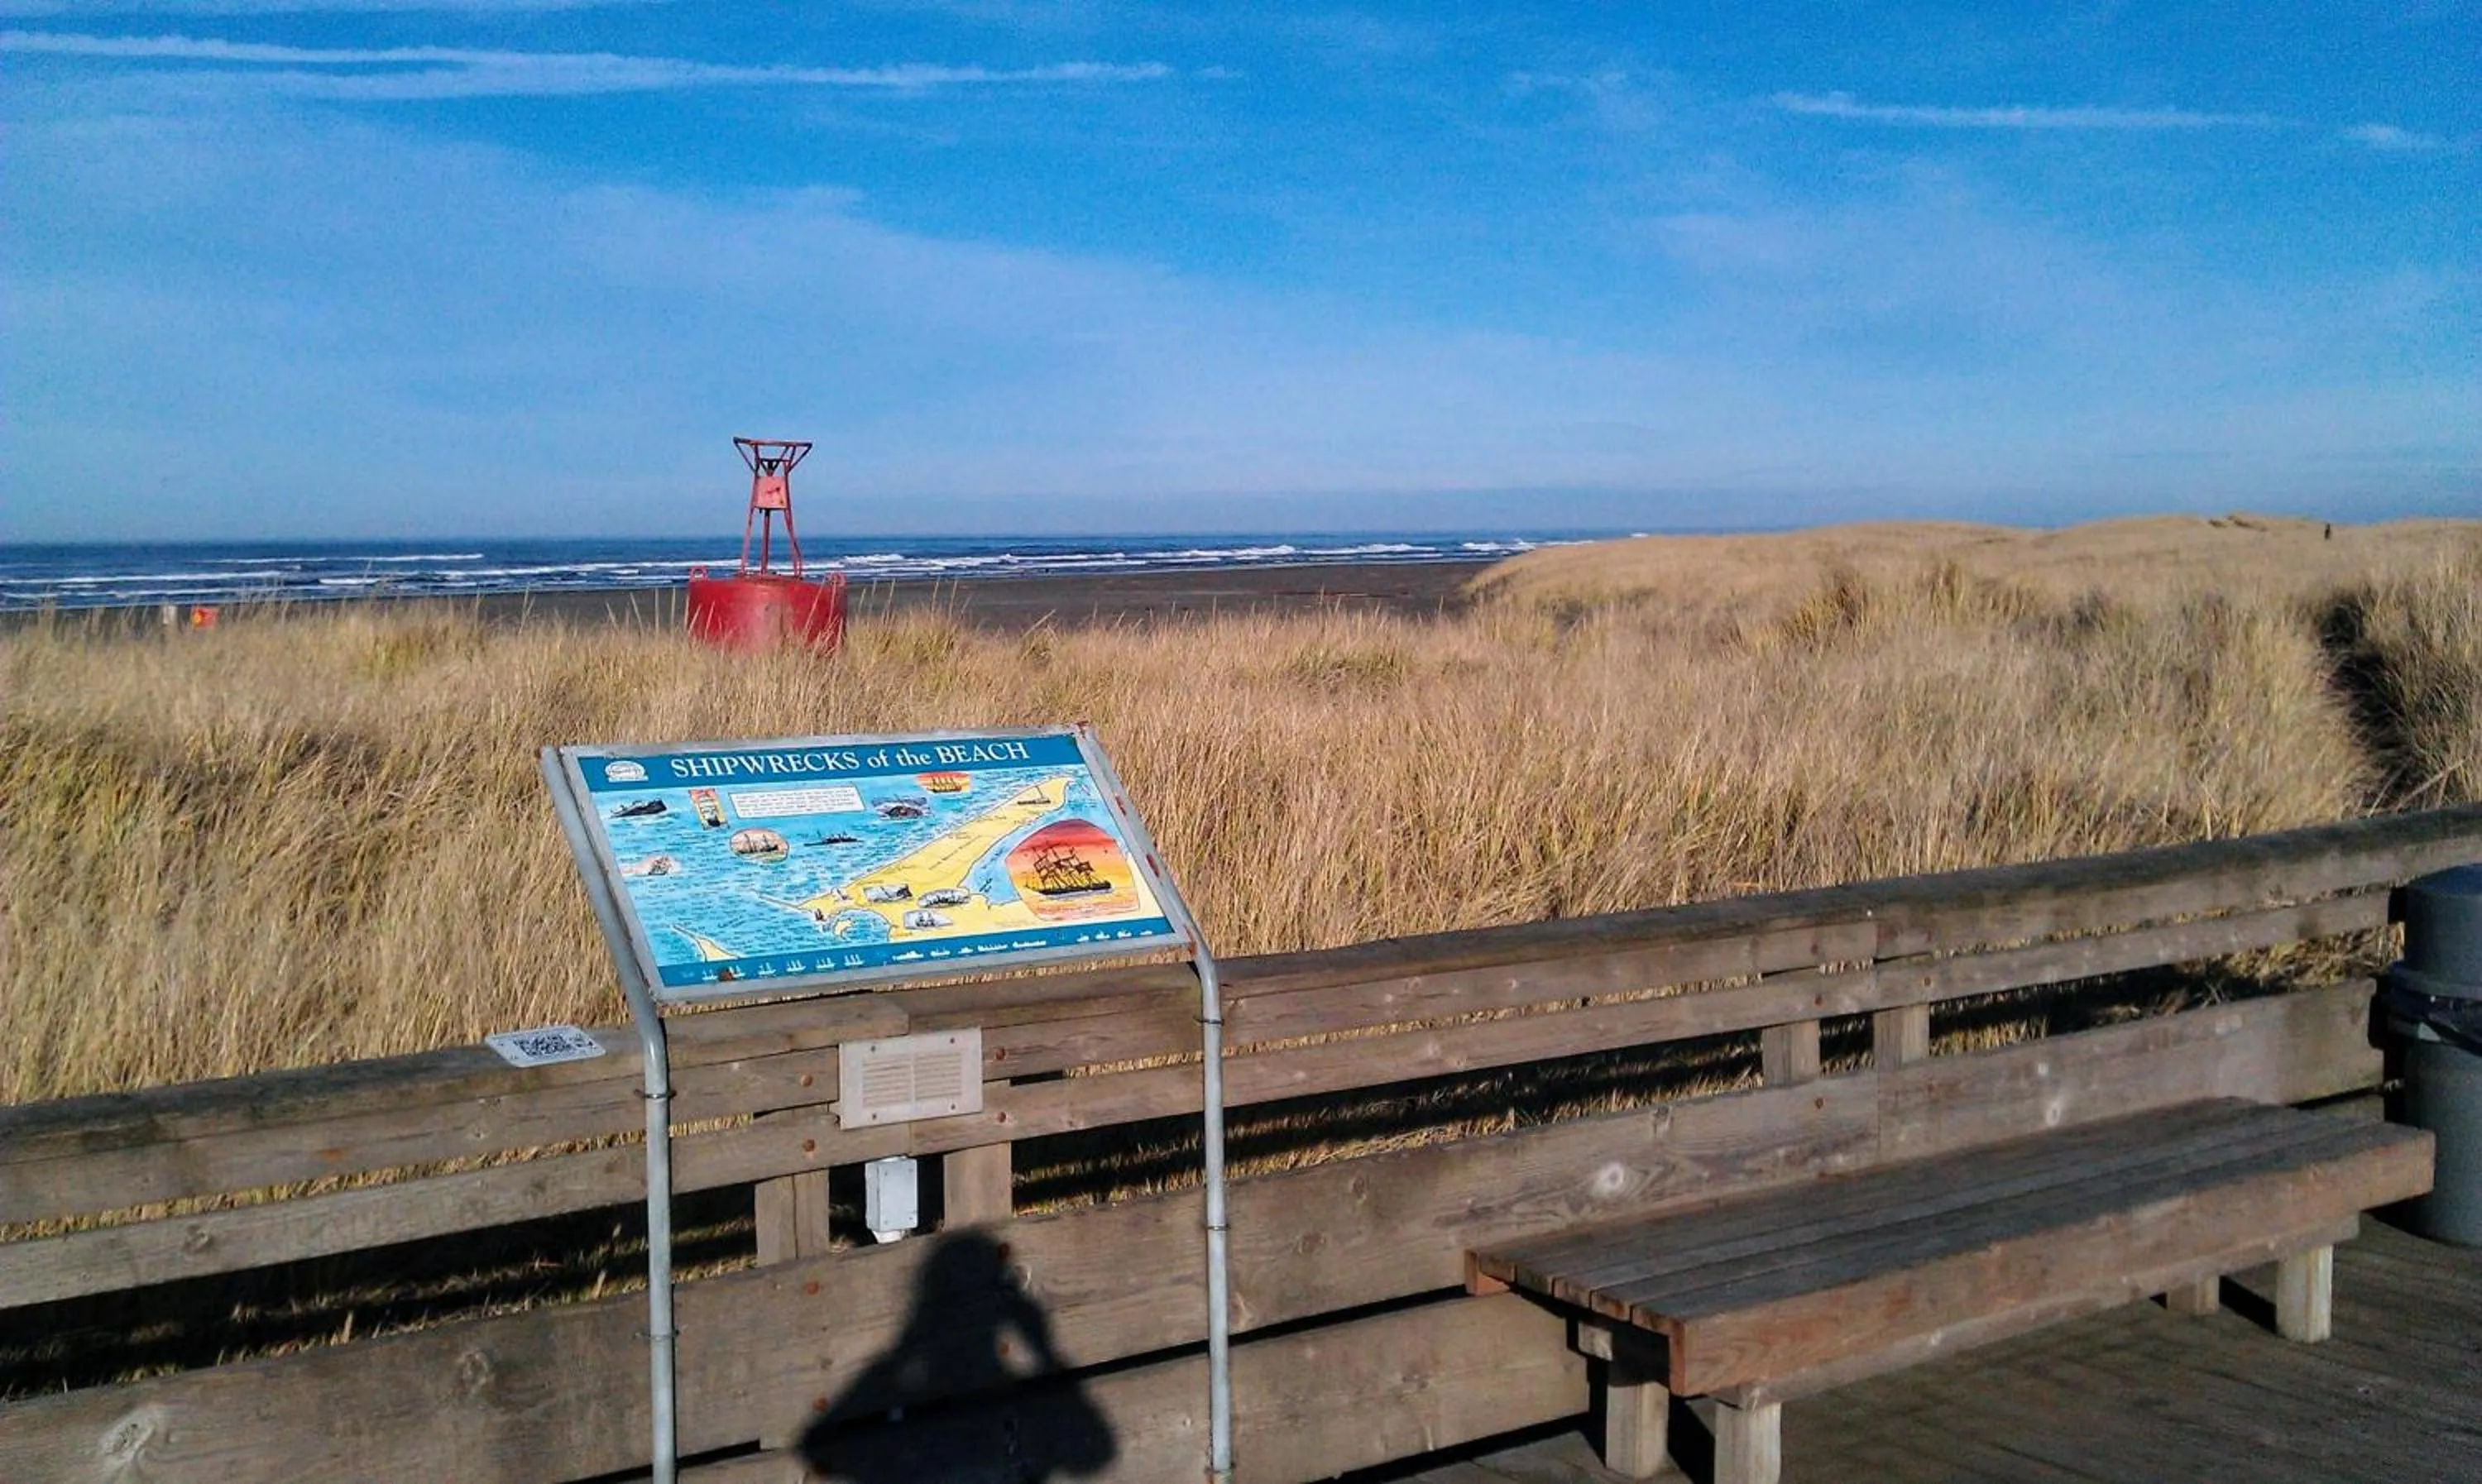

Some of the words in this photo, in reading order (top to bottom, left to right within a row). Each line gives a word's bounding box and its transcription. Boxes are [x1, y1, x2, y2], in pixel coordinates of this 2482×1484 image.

[671, 751, 860, 778] SHIPWRECKS
[867, 749, 890, 768] of
[895, 748, 932, 766] the
[935, 742, 1029, 764] BEACH
